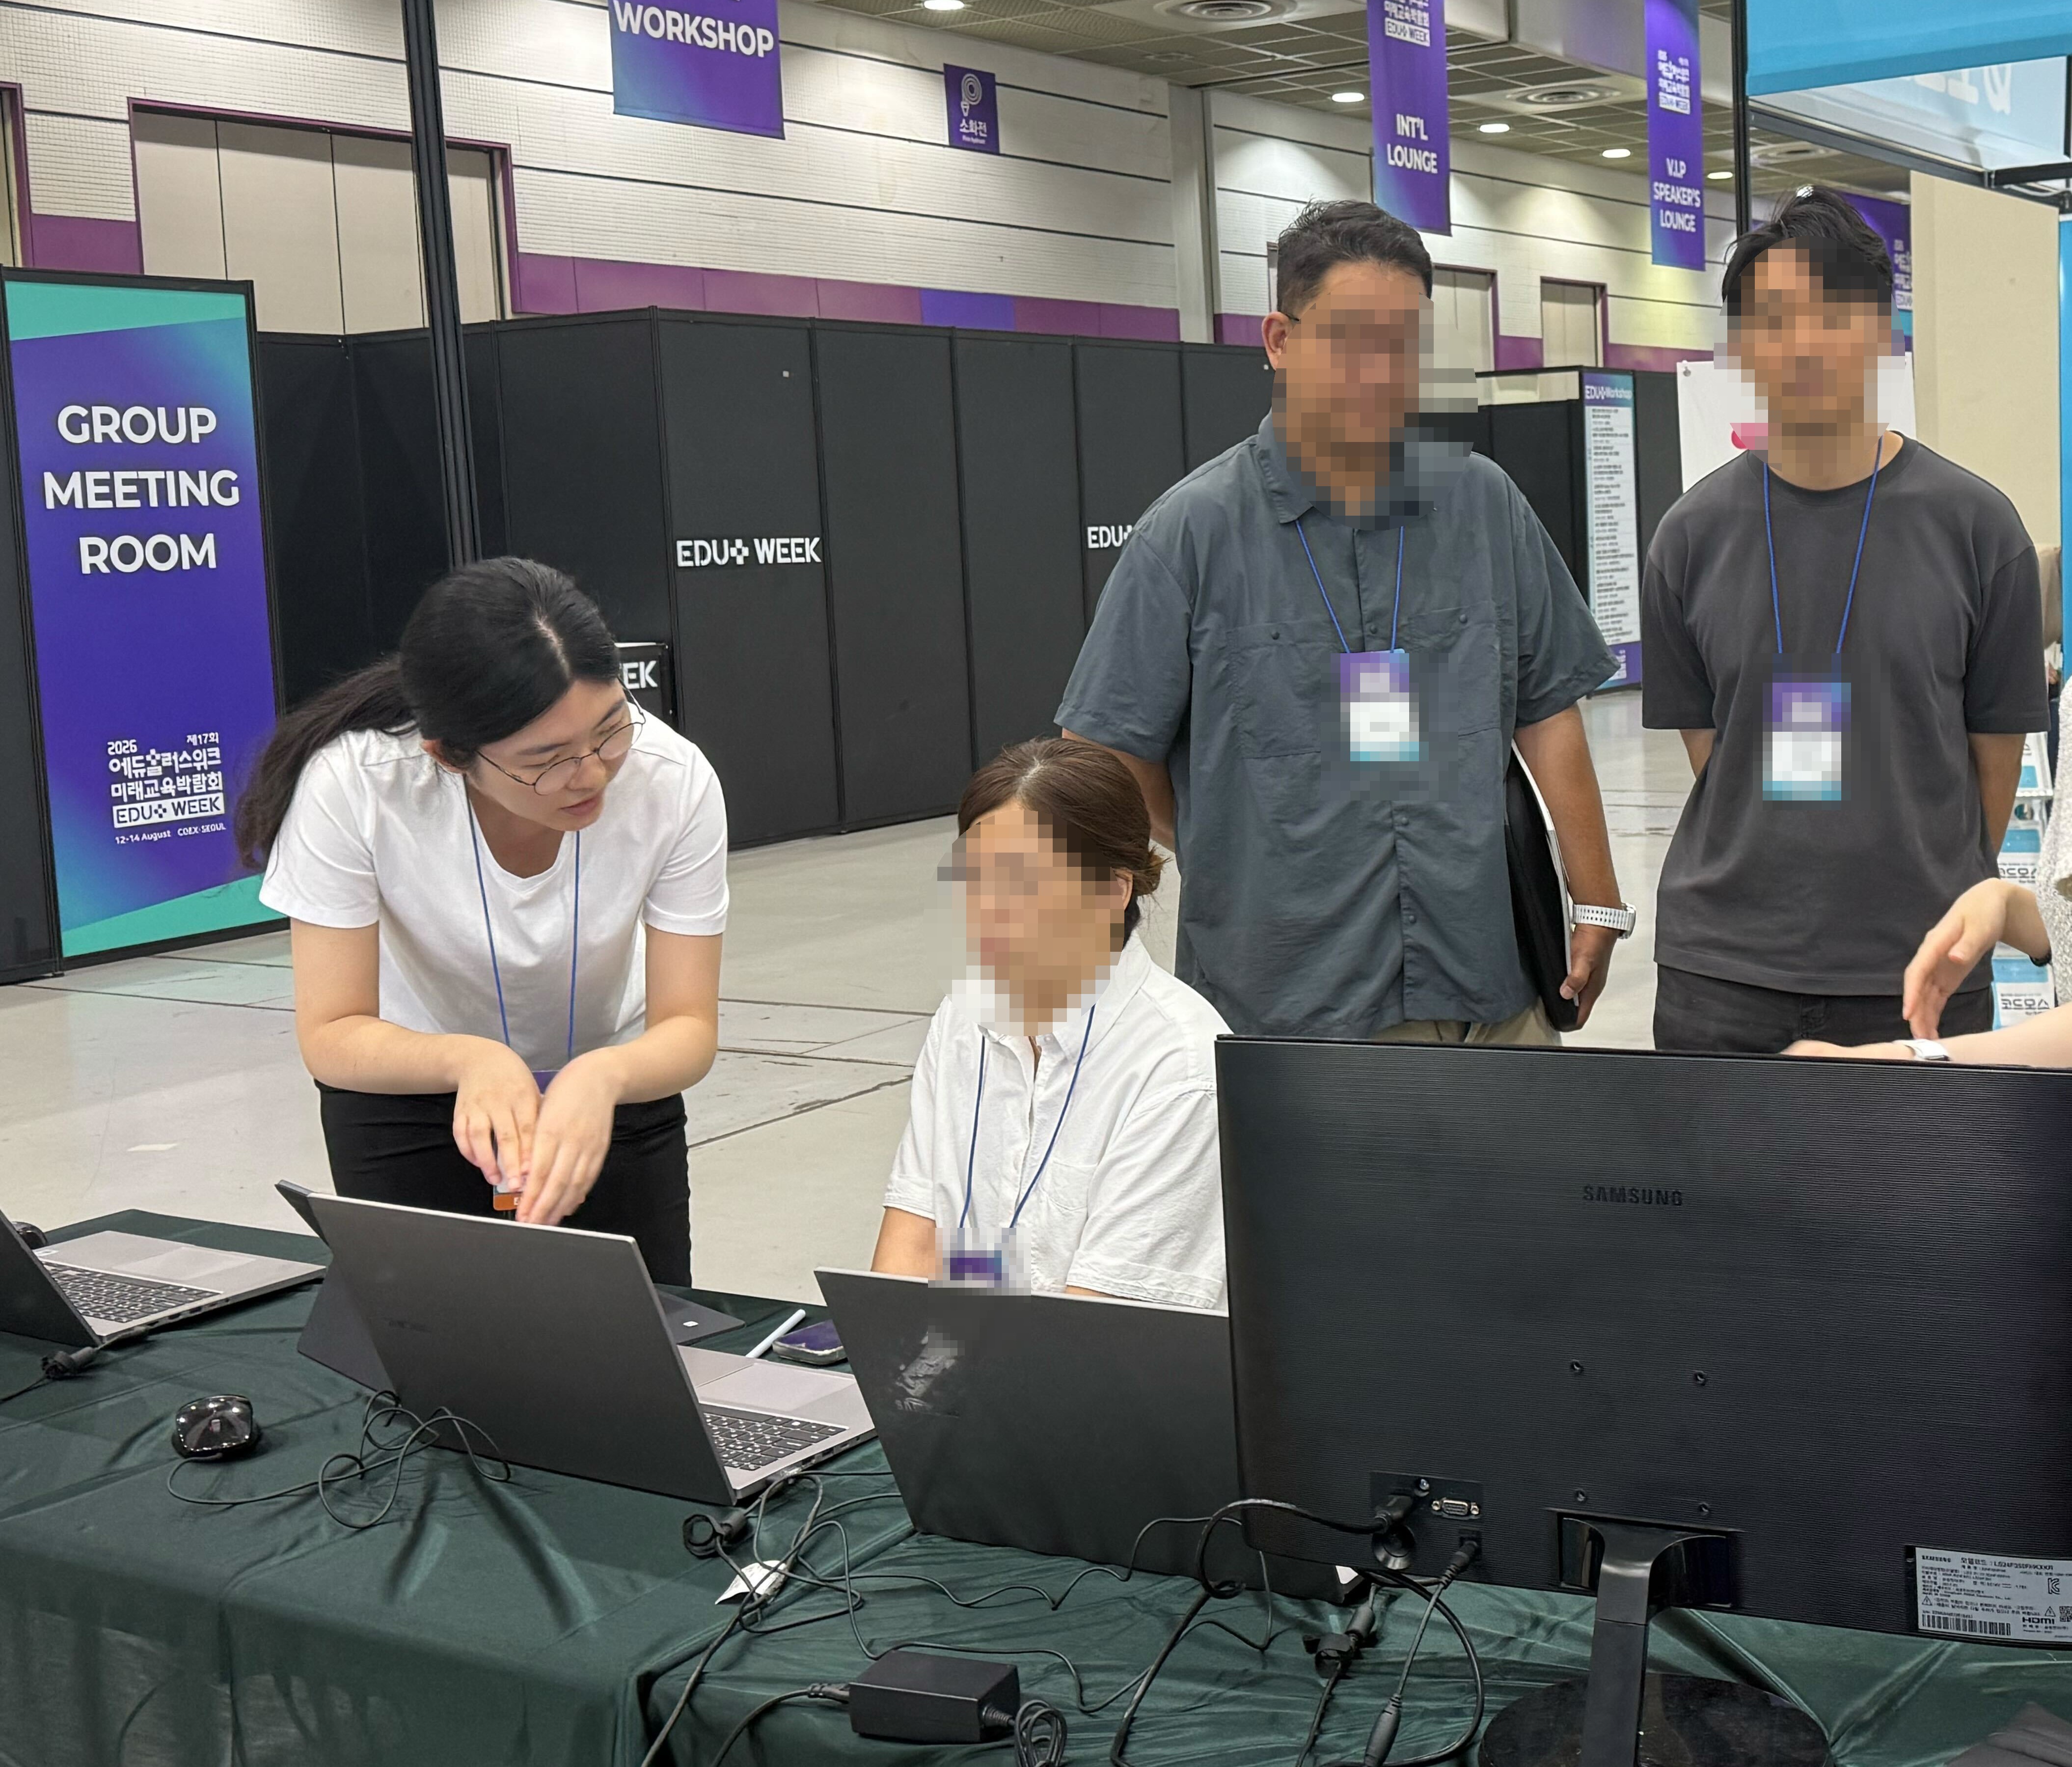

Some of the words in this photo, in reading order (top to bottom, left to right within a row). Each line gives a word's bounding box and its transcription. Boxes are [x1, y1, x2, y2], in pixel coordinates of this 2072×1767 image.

[613, 0, 774, 57] WORKSHOP
[1396, 113, 1428, 141] INT'L
[1387, 143, 1438, 174] LOUNGE
[1653, 181, 1701, 207] SPEAKER'S
[1660, 209, 1696, 232] LOUNGE
[57, 405, 217, 444] GROUP
[43, 470, 240, 509] MEETING
[79, 533, 217, 574] ROOM
[753, 537, 822, 564] WEEK
[619, 660, 658, 689] EK
[107, 739, 137, 755] 2026
[187, 732, 219, 746] 제17회
[110, 771, 223, 802] 미래교육박람회
[171, 796, 220, 817] WEEK
[141, 830, 171, 841] August
[1582, 1185, 1683, 1206] SAMSUNG
